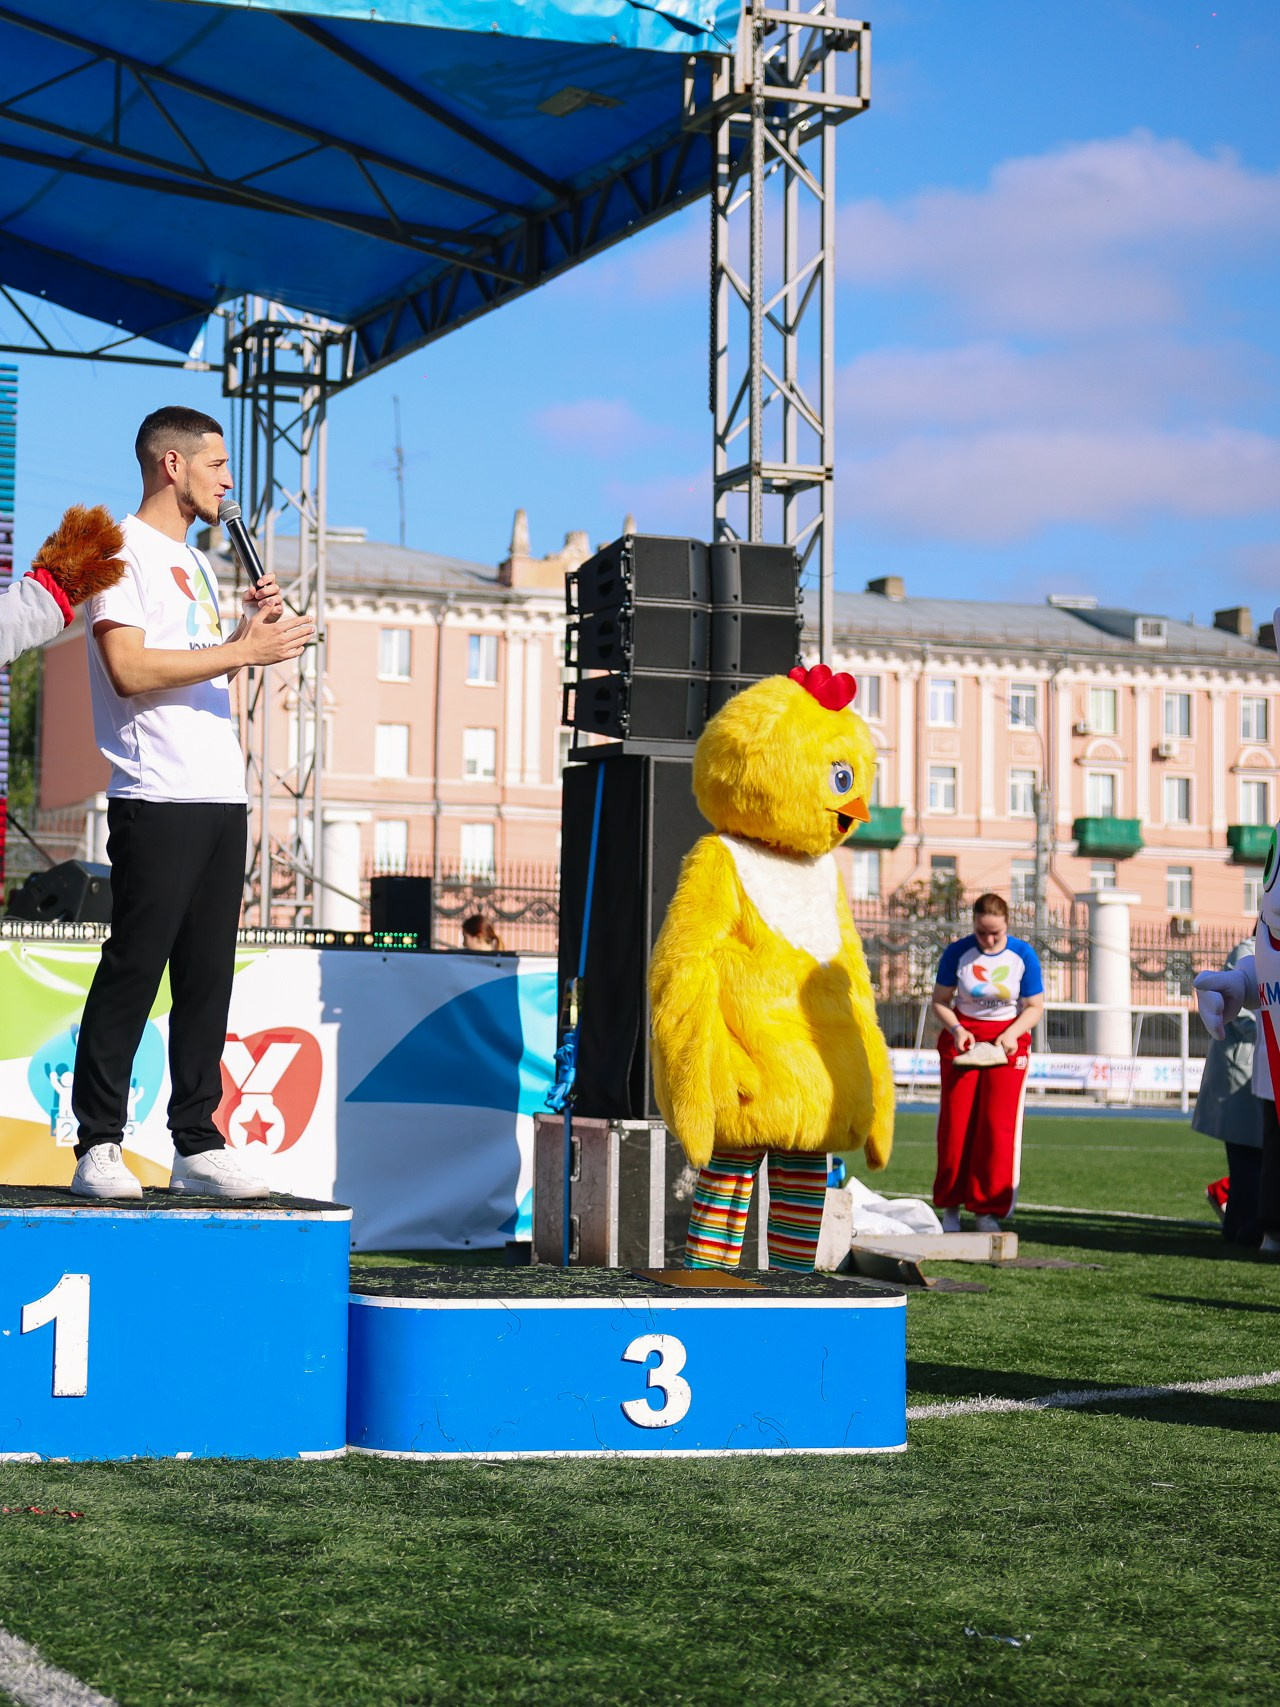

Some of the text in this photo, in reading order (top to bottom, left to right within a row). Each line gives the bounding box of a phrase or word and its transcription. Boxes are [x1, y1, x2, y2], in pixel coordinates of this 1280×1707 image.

[61, 1122, 74, 1143] 2
[21, 1274, 90, 1397] 1
[621, 1333, 692, 1428] 3
